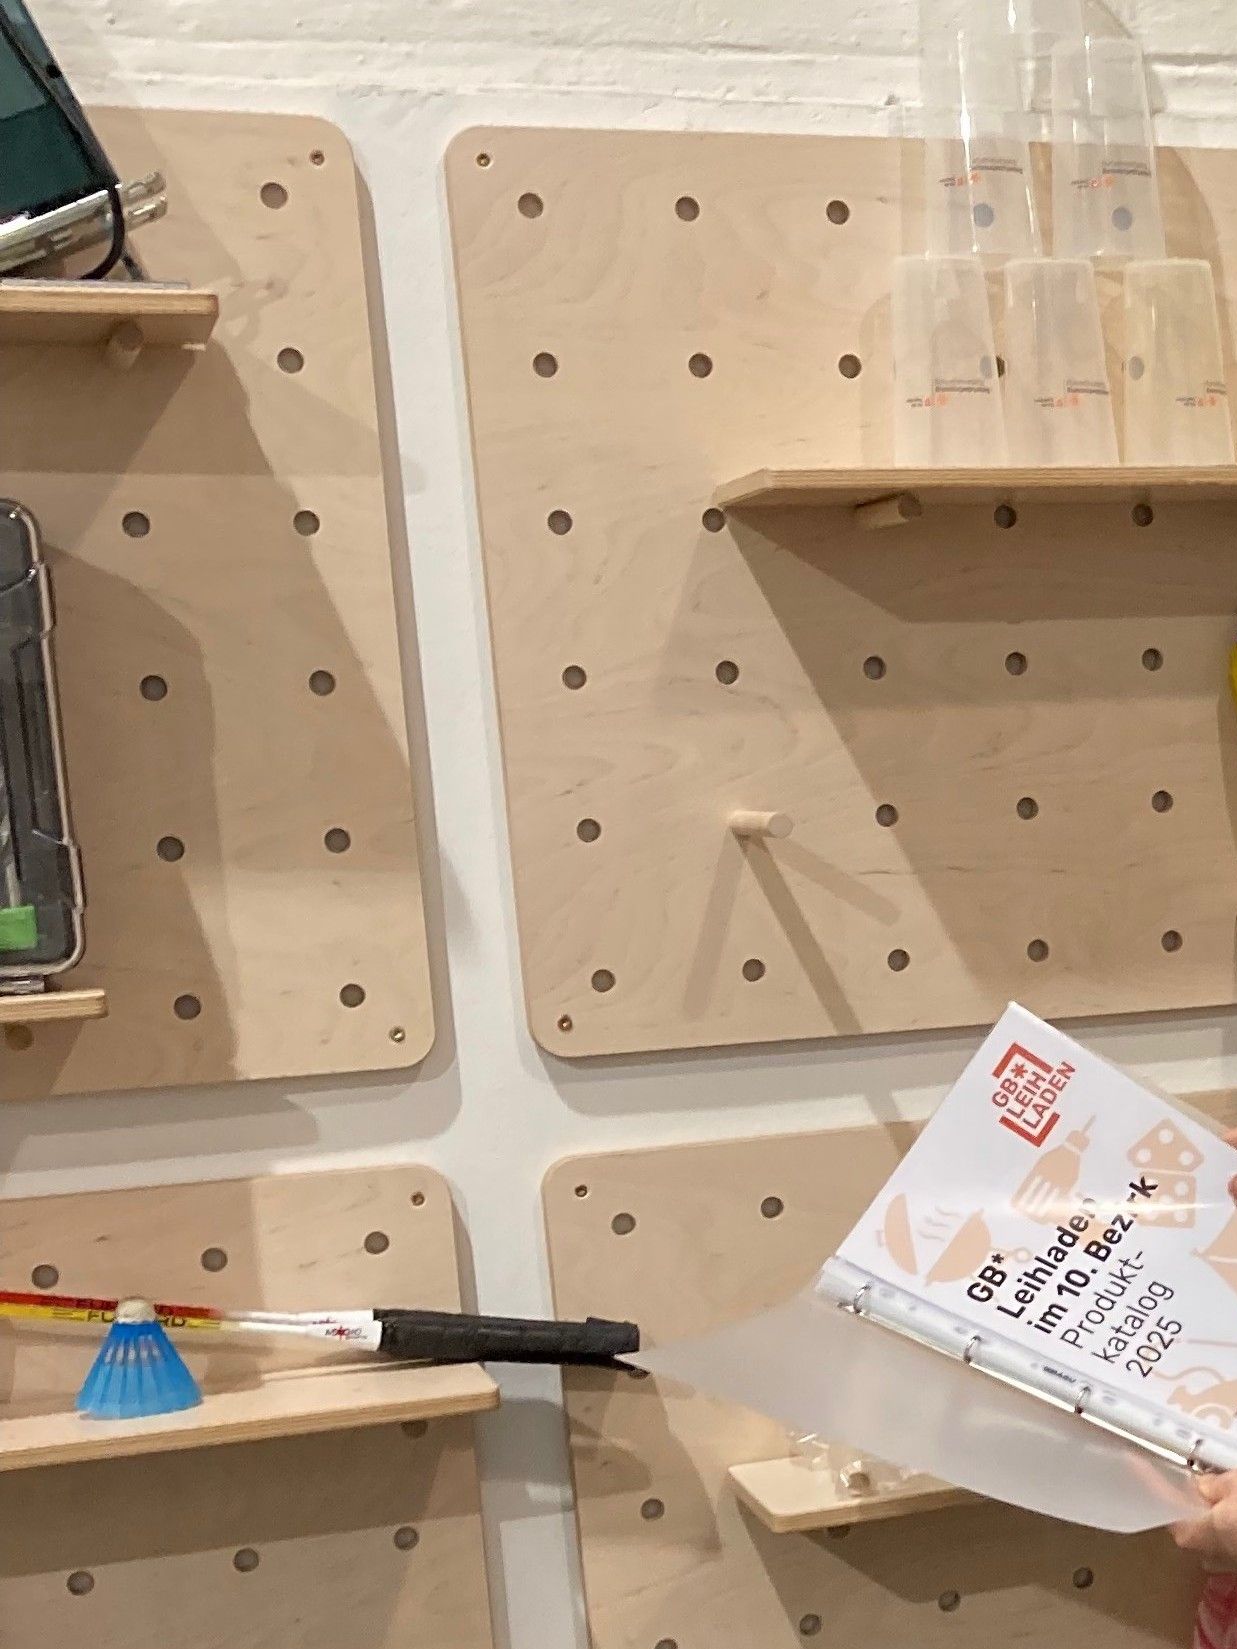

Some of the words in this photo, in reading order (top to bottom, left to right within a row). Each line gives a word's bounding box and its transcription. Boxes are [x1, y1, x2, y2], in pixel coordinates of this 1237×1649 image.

[1006, 1070, 1047, 1119] LEIH
[1022, 1061, 1076, 1129] LADEN
[1027, 1303, 1069, 1334] im
[1056, 1268, 1098, 1297] 10.
[1060, 1251, 1144, 1349] Produkt-
[1091, 1281, 1175, 1364] katalog
[1126, 1316, 1182, 1378] 2025
